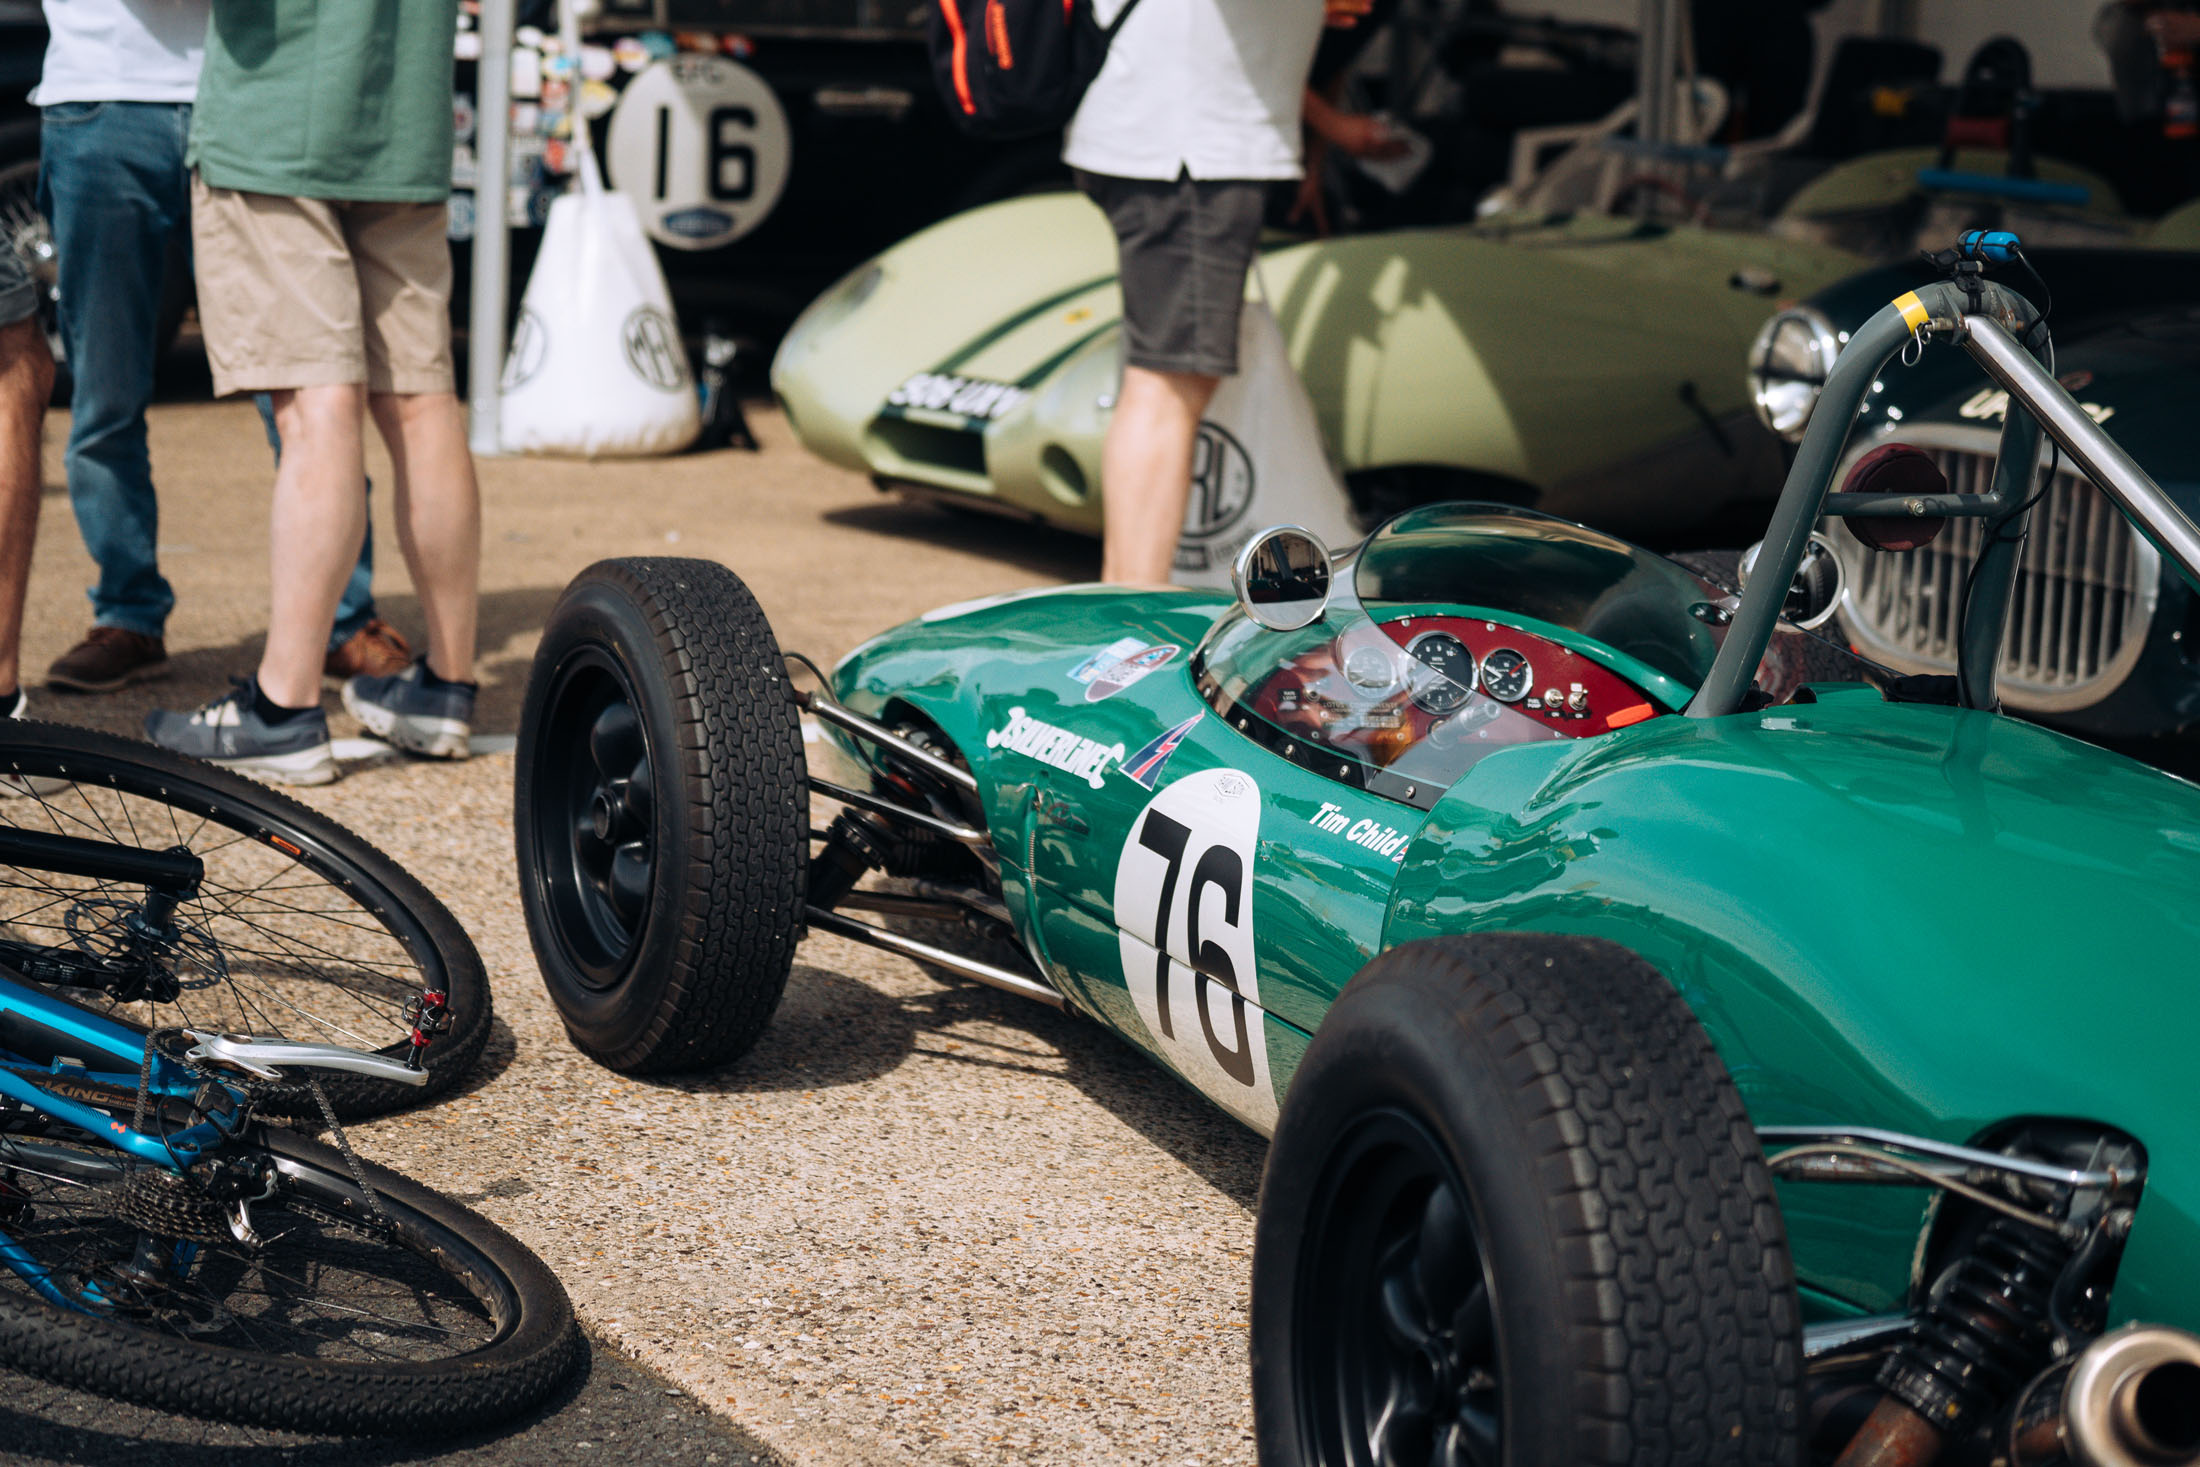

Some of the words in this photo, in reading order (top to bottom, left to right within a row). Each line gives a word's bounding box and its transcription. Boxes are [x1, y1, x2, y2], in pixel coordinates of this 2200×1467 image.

[657, 105, 757, 200] 16
[1309, 801, 1351, 835] Tim
[1346, 818, 1409, 857] Child
[1138, 807, 1255, 1088] 76
